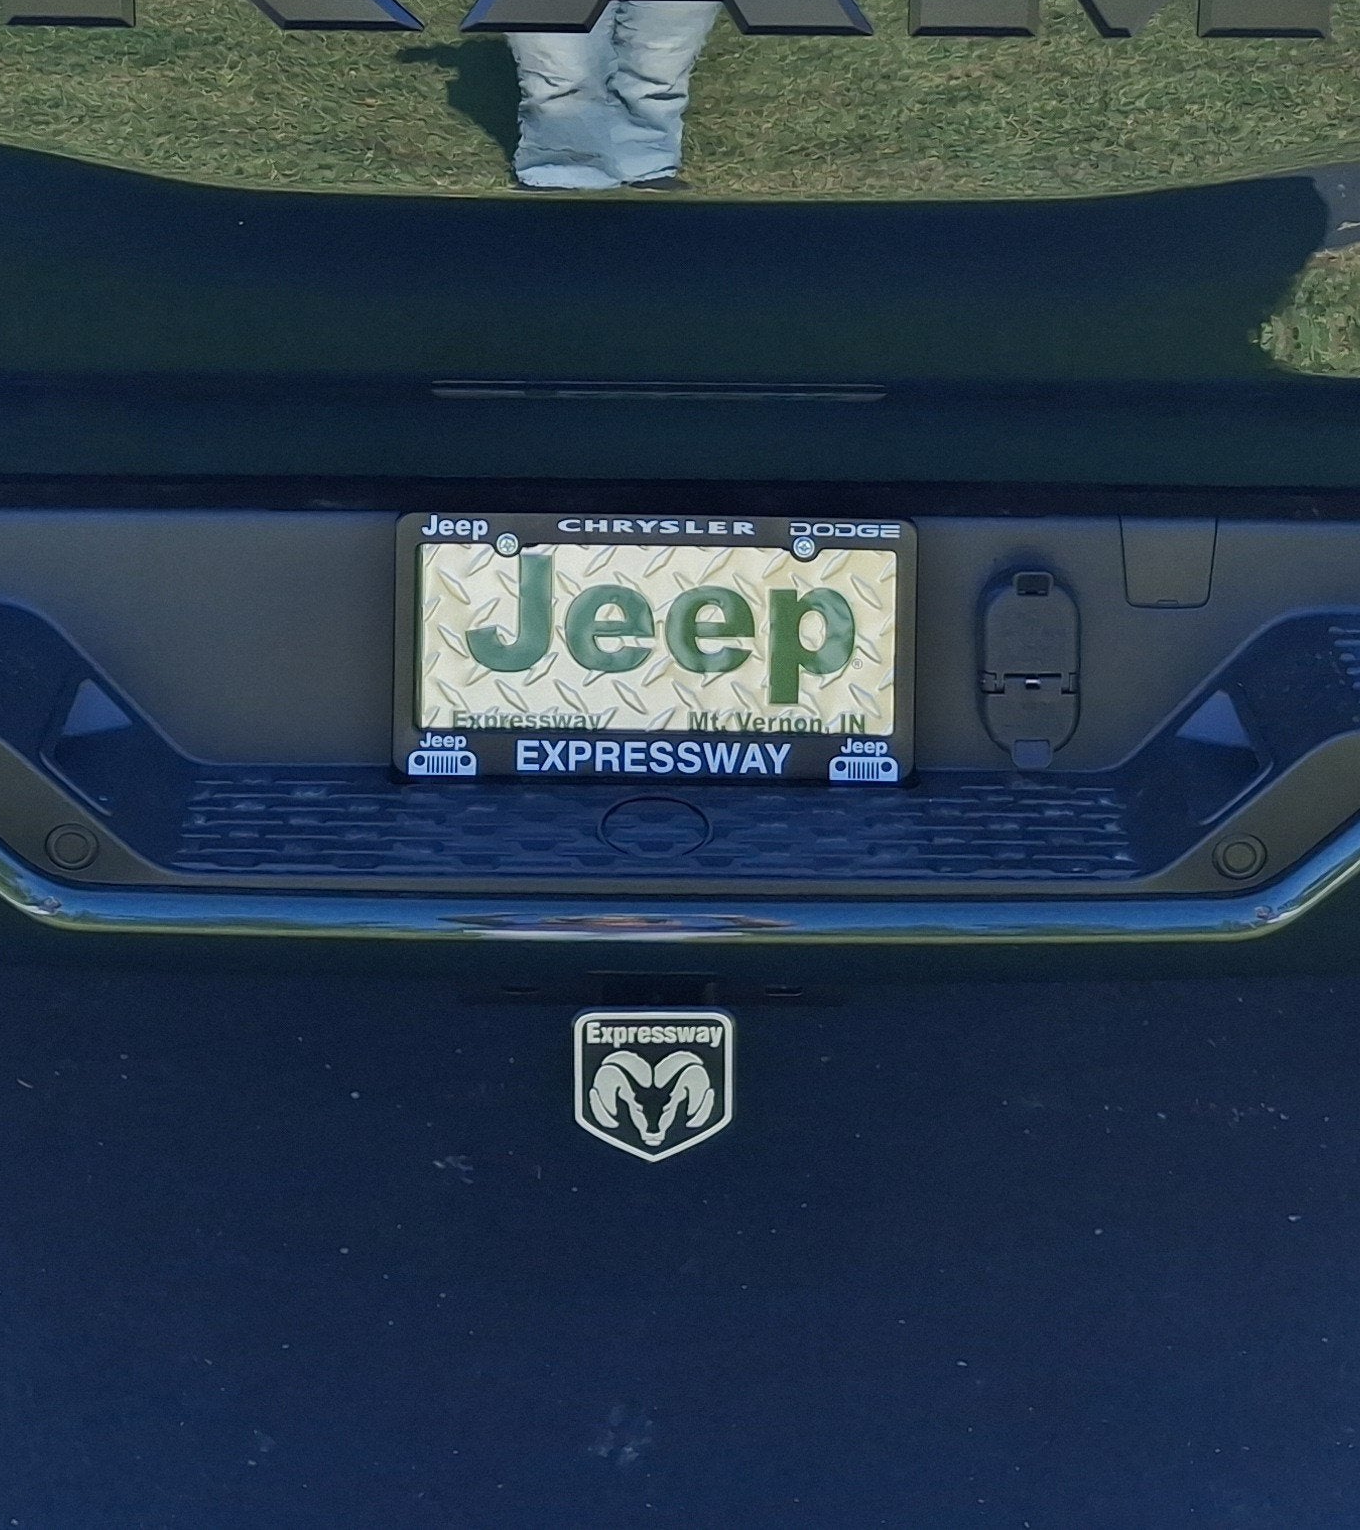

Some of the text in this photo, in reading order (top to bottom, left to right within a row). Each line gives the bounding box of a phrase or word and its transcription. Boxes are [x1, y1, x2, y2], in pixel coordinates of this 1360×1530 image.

[421, 514, 489, 541] Jeep
[557, 518, 756, 536] CHRYSLER
[789, 522, 901, 539] DODGE
[465, 553, 856, 705] Jeep
[452, 709, 603, 731] Expressway
[689, 711, 866, 735] Mt. Vernon, IN
[419, 732, 467, 750] Jeep
[840, 737, 888, 756] Jeep
[516, 739, 791, 774] EXPRESSWAY
[586, 1021, 723, 1049] Expressway
